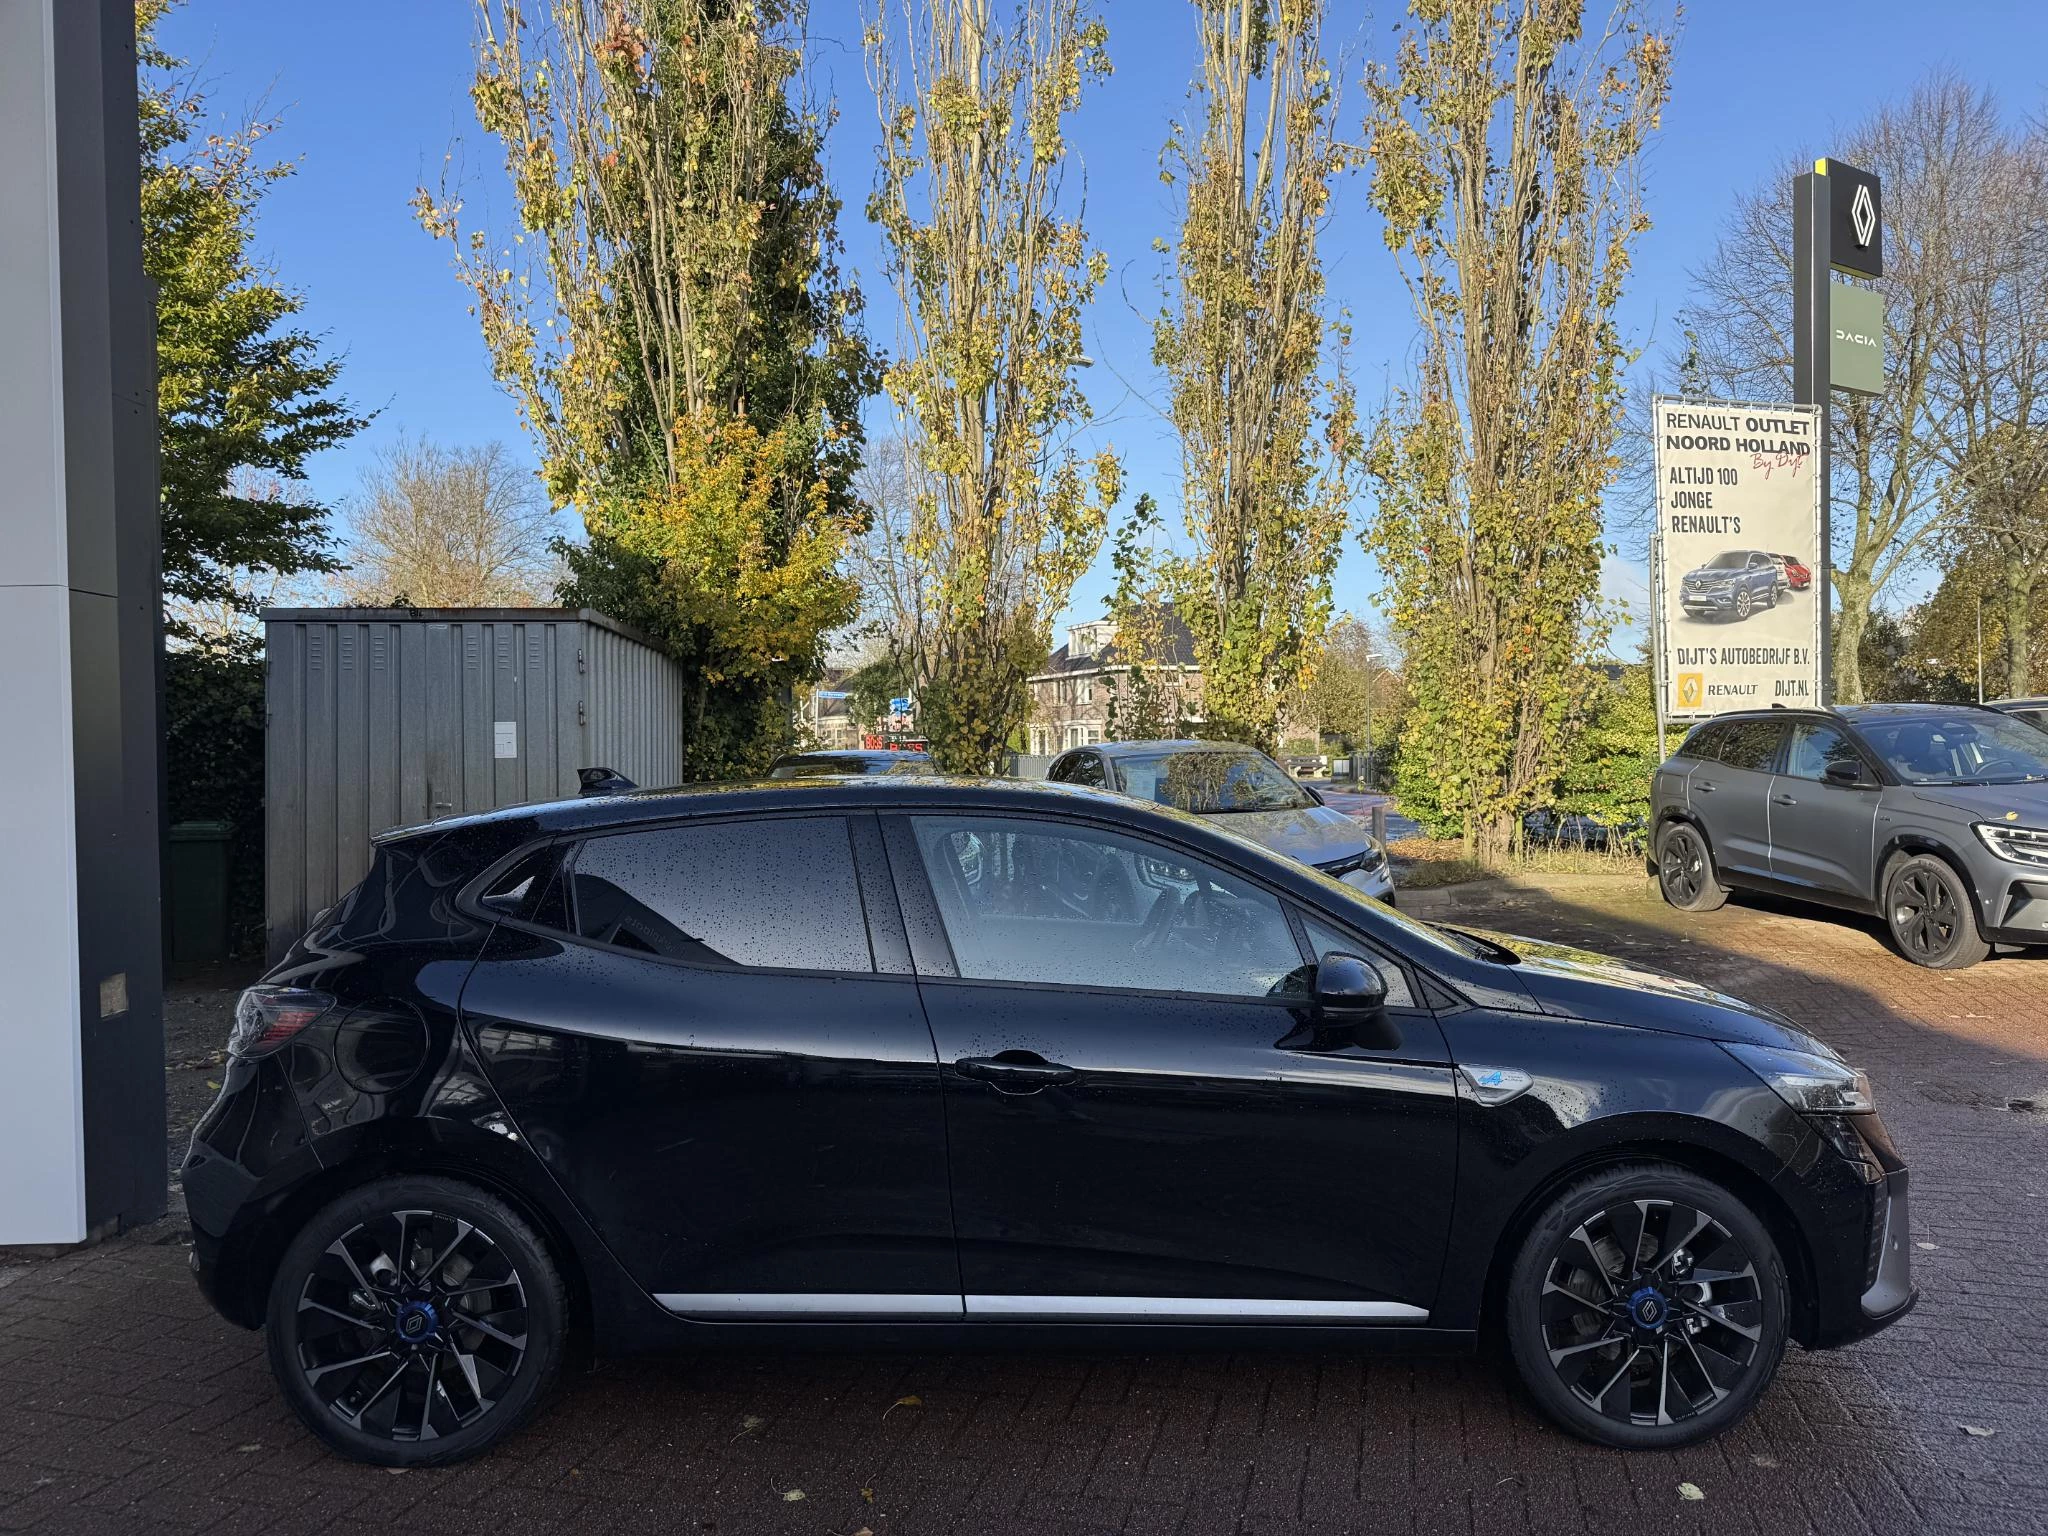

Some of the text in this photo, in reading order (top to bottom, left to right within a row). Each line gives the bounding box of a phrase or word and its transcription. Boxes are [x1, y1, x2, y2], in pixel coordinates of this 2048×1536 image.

[1835, 329, 1877, 347] DACIA
[1666, 412, 1810, 435] RENAULT OUTLET
[1666, 435, 1811, 456] NOORD HOLLAND
[1750, 452, 1774, 480] By
[1669, 467, 1738, 486] ALTIJD 100
[1670, 491, 1713, 509] JONGE
[1671, 515, 1741, 534] RENAULT'S
[1677, 647, 1810, 665] DIJT'S AUTOBEDRIJF B.V.
[1707, 679, 1810, 697] RENAULT DIJT.NL
